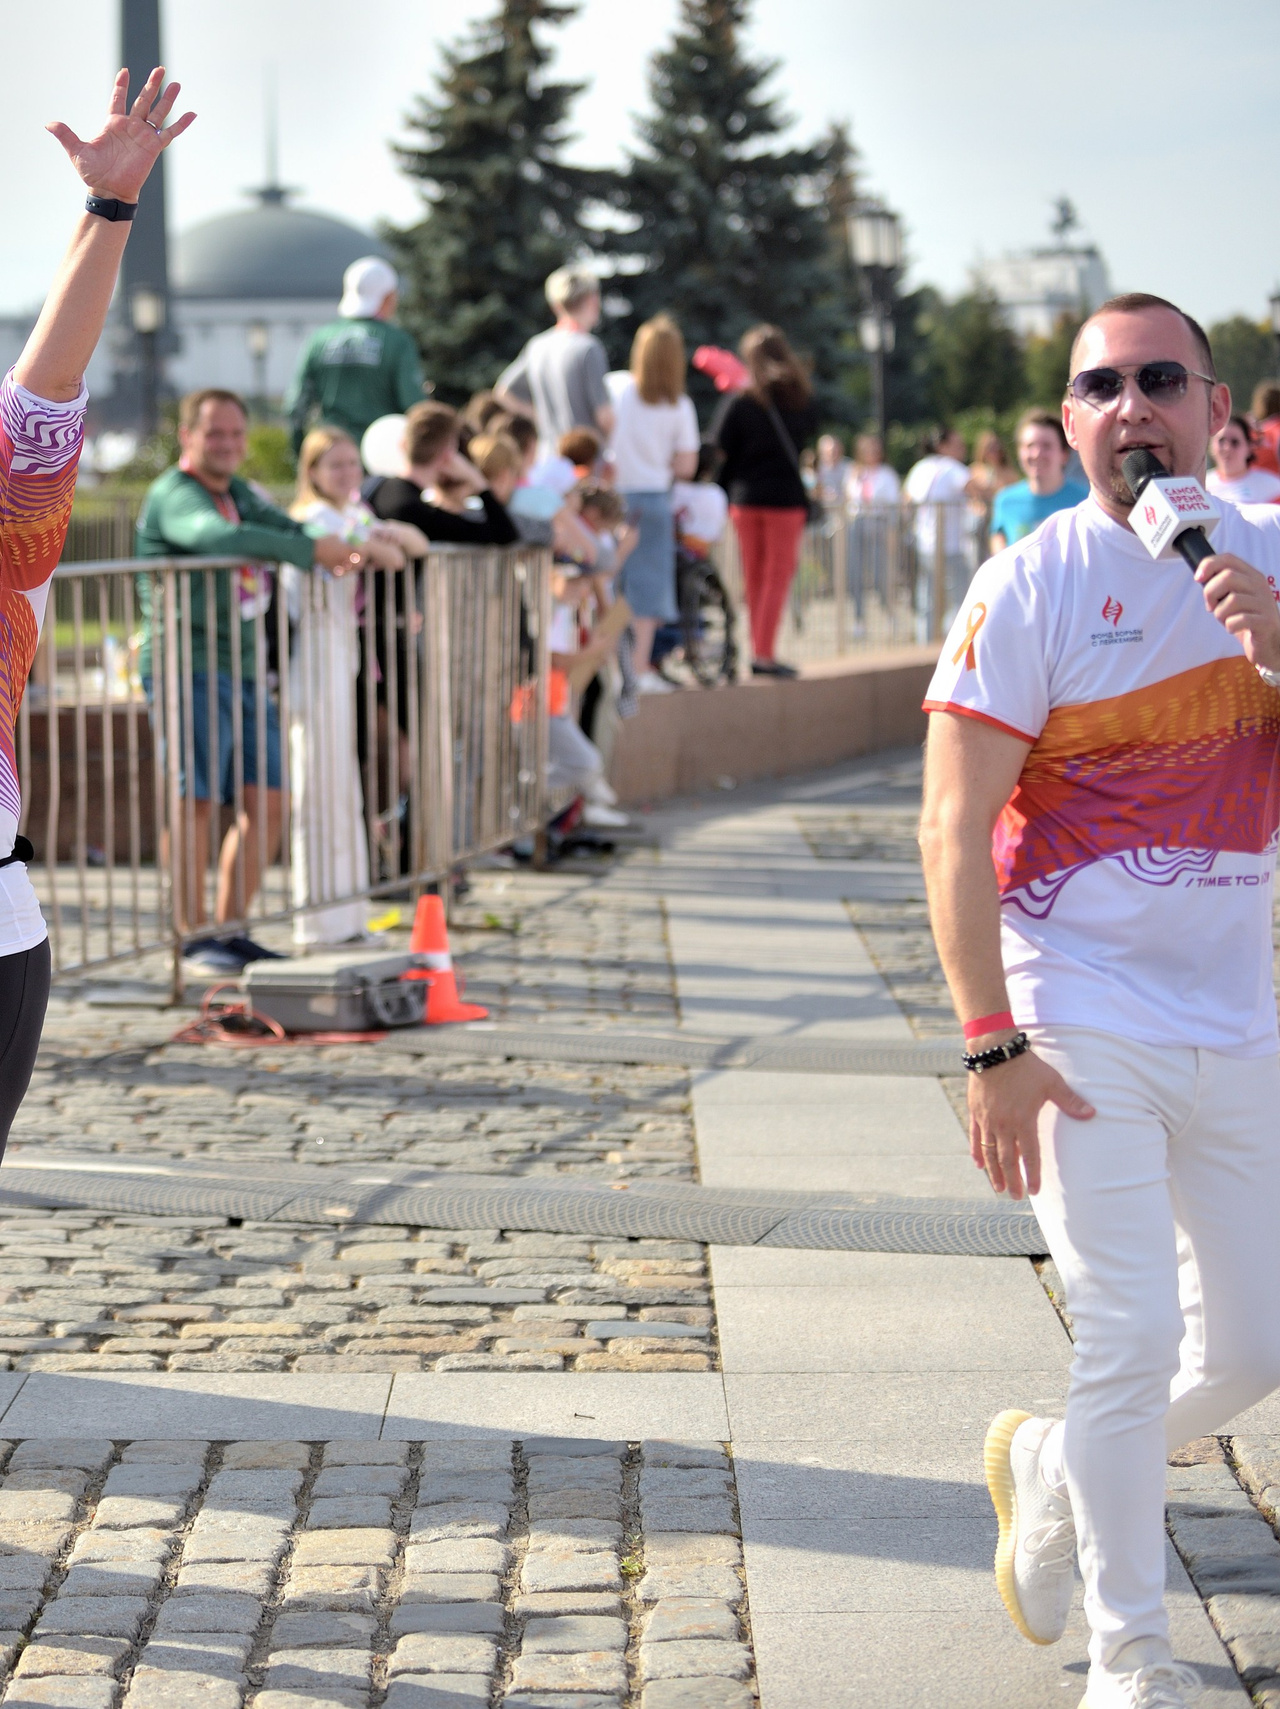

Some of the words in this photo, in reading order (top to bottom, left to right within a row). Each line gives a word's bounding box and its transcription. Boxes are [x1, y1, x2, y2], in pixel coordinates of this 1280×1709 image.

[1164, 486, 1200, 496] САМОЕ
[1169, 494, 1205, 504] ВРЕМЯ
[1175, 503, 1210, 512] ЖИТЬ
